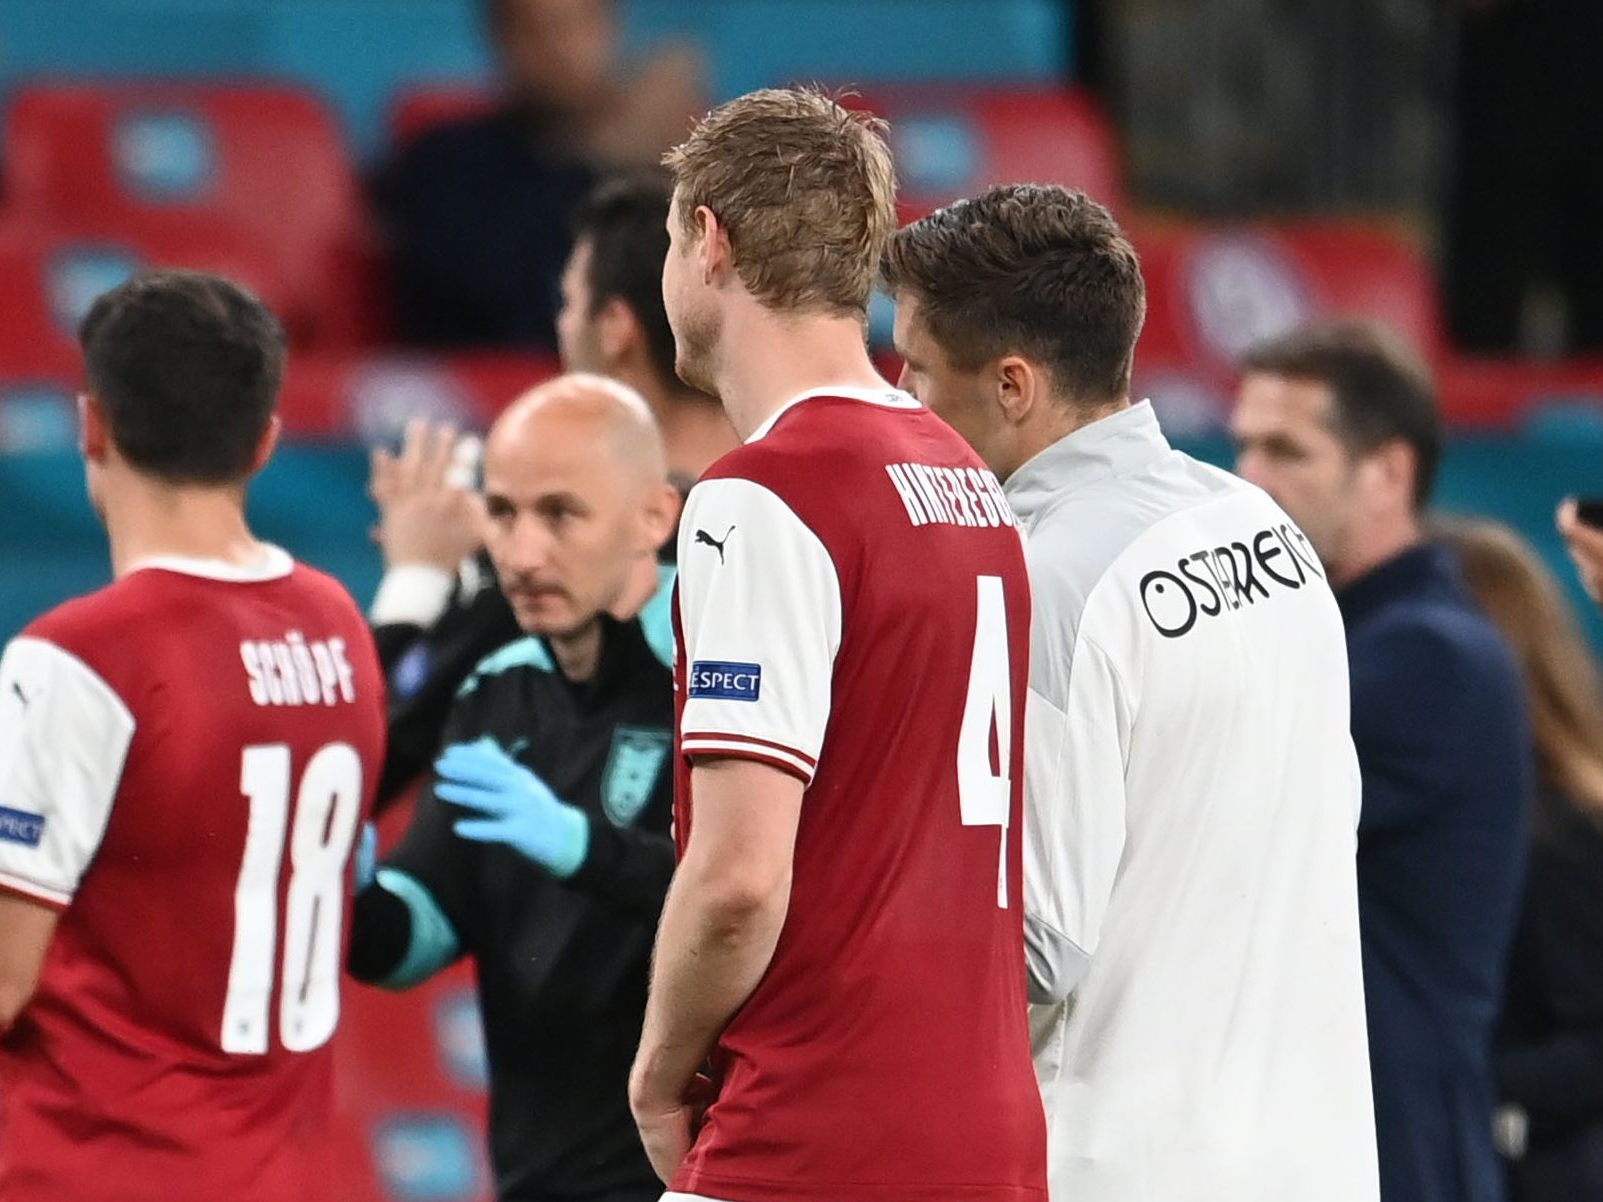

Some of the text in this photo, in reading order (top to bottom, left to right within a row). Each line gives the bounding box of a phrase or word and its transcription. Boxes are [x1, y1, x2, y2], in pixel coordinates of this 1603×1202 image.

[885, 463, 1020, 528] HINTEREGG
[957, 575, 1011, 909] 4
[221, 743, 362, 1054] 18
